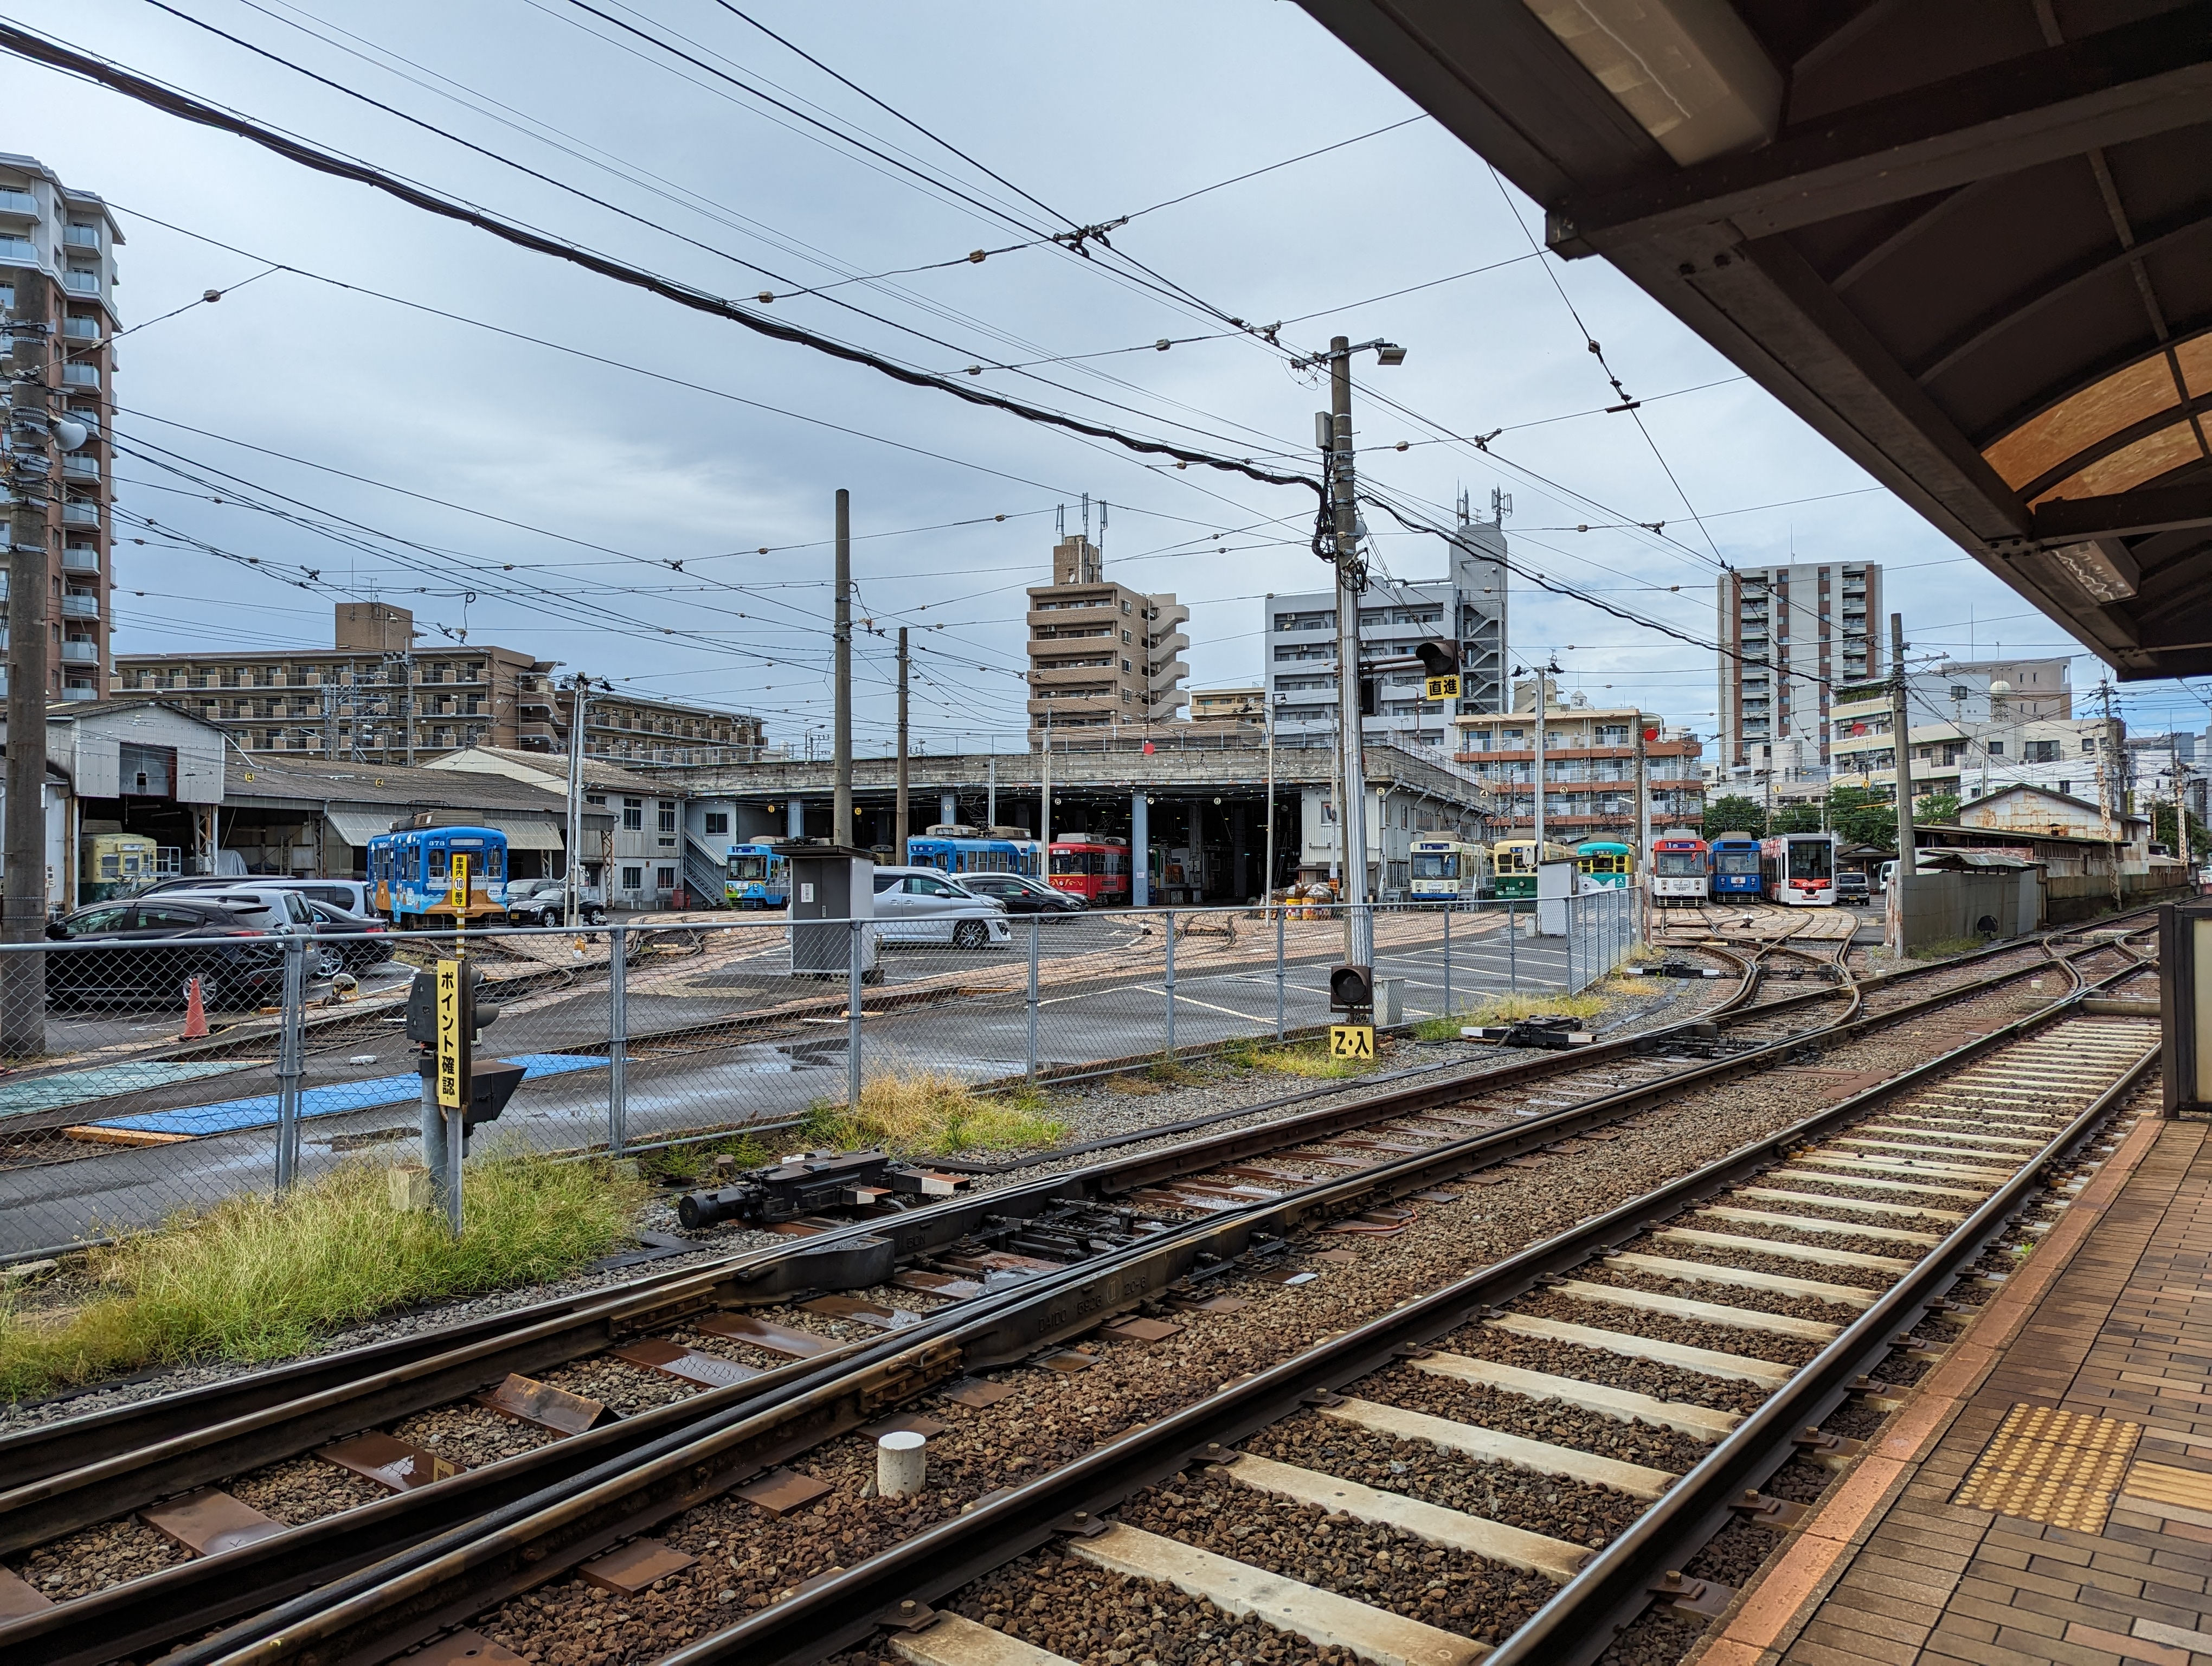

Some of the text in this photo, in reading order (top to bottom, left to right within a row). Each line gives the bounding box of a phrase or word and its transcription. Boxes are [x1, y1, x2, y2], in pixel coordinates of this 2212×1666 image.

[1429, 678, 1457, 696] 直進
[441, 972, 455, 1095] ポイント確認
[907, 1234, 925, 1247] 50N
[1038, 1309, 1066, 1333] DAIDO
